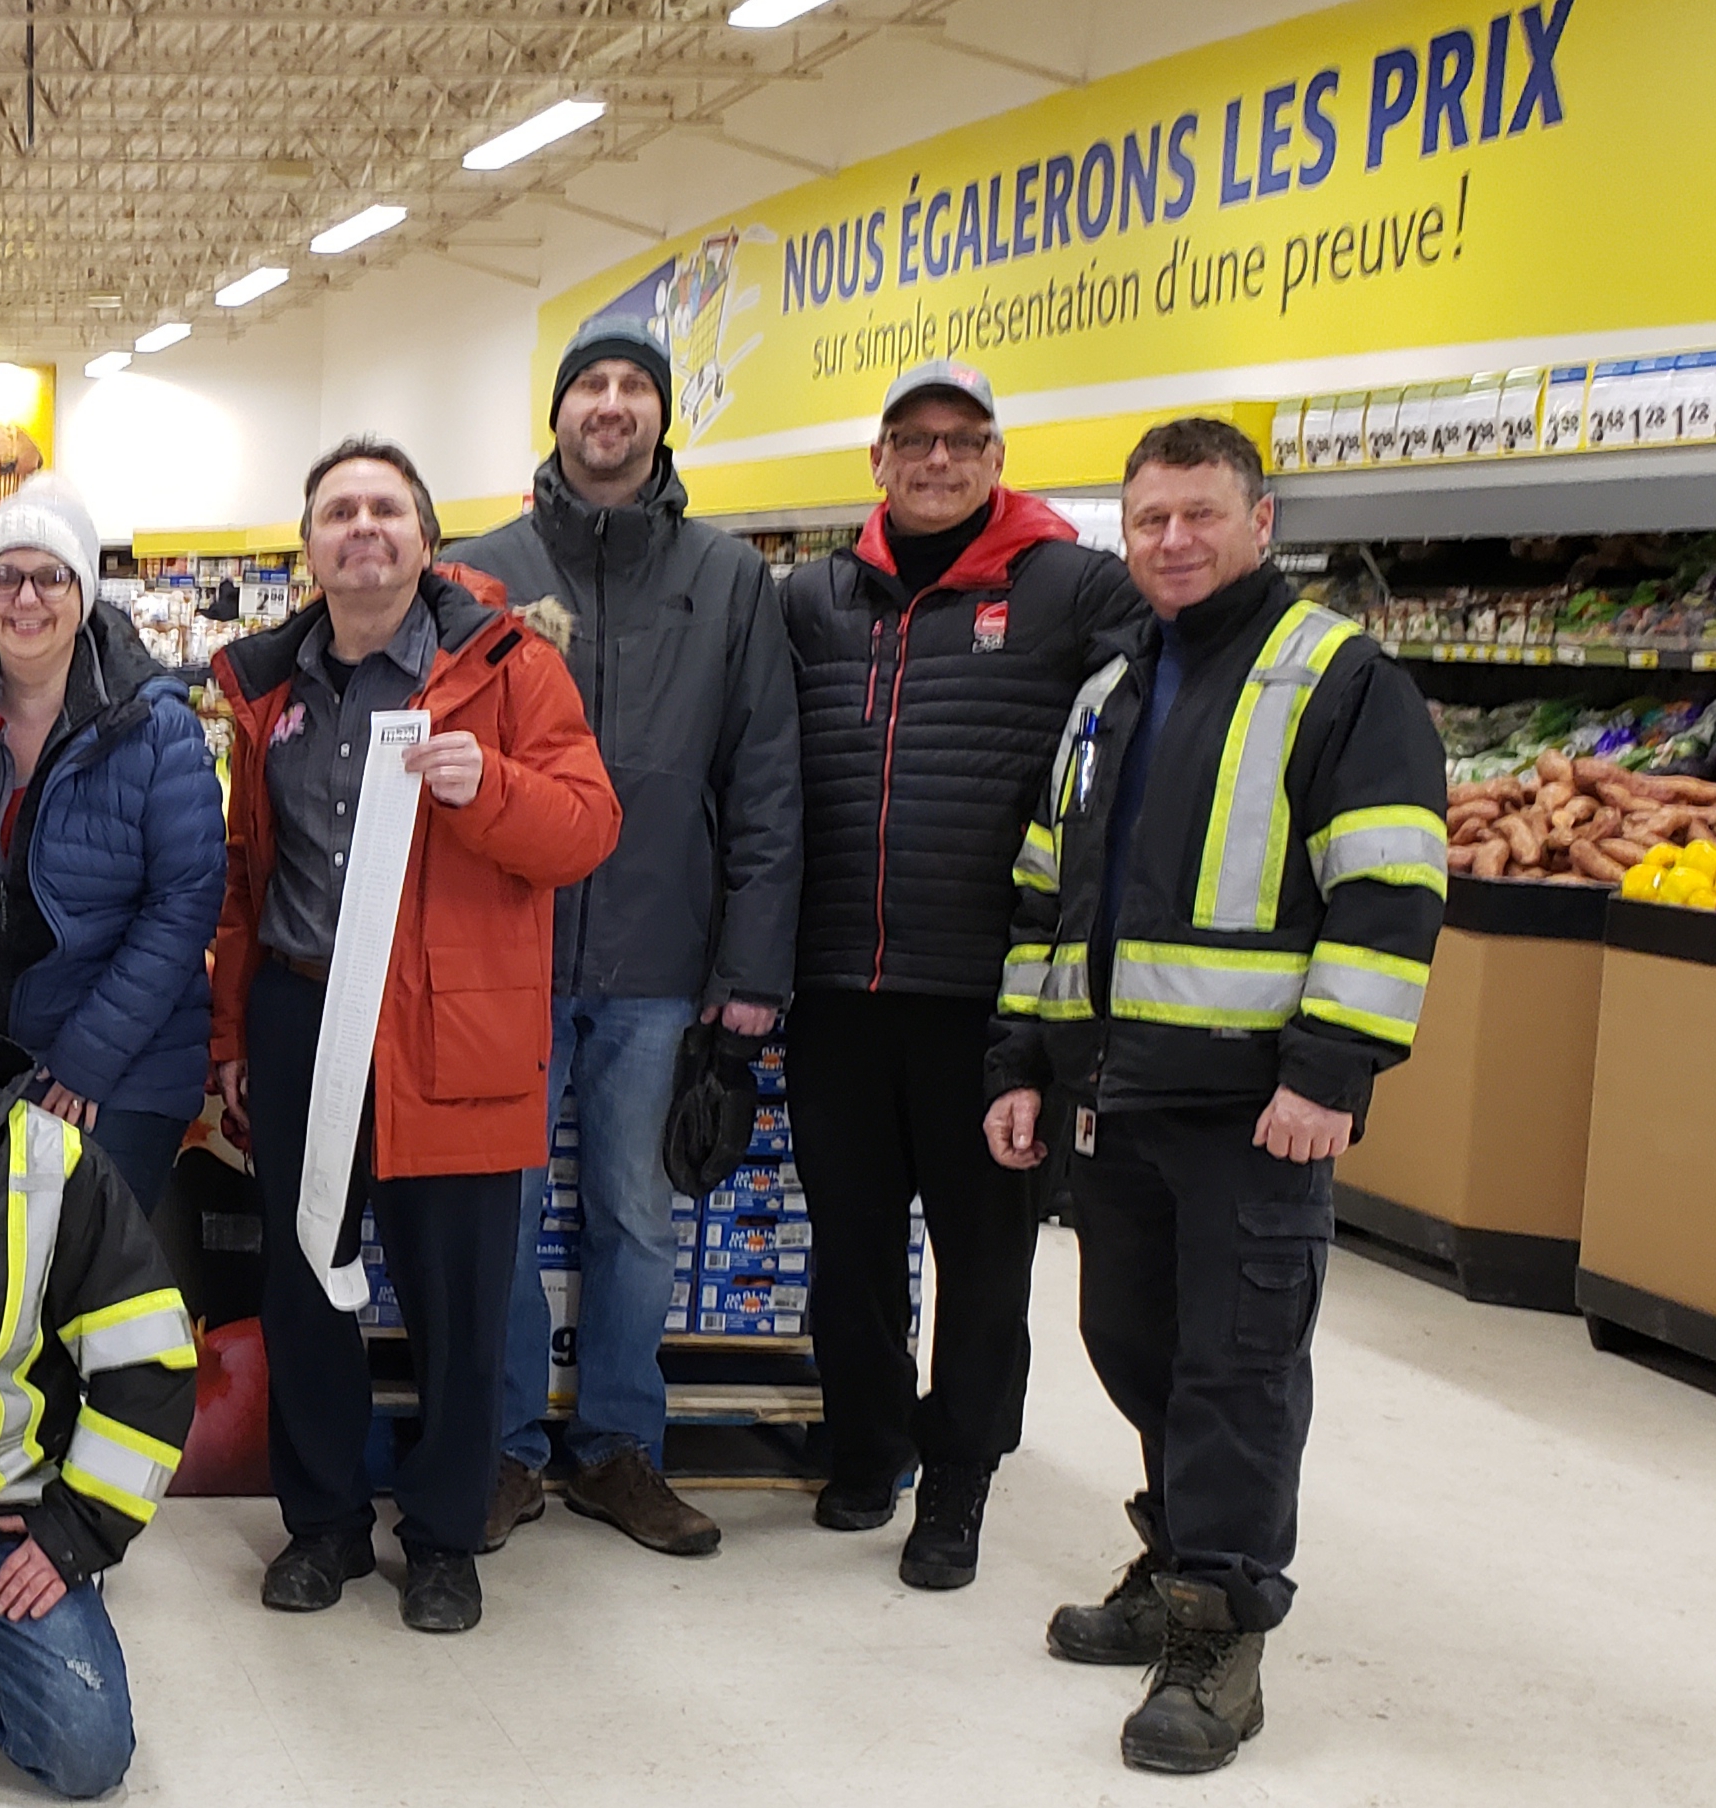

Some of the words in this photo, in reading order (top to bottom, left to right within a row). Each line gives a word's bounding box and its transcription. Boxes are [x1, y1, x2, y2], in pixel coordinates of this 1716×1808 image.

[783, 207, 886, 315] NOUS
[898, 113, 1198, 286] ÉGALERONS
[1219, 69, 1340, 208] LES
[1365, 0, 1574, 172] PRIX
[813, 332, 847, 379] sur
[854, 297, 936, 378] simple
[946, 256, 1140, 362] présentation
[1155, 235, 1265, 316] d'une
